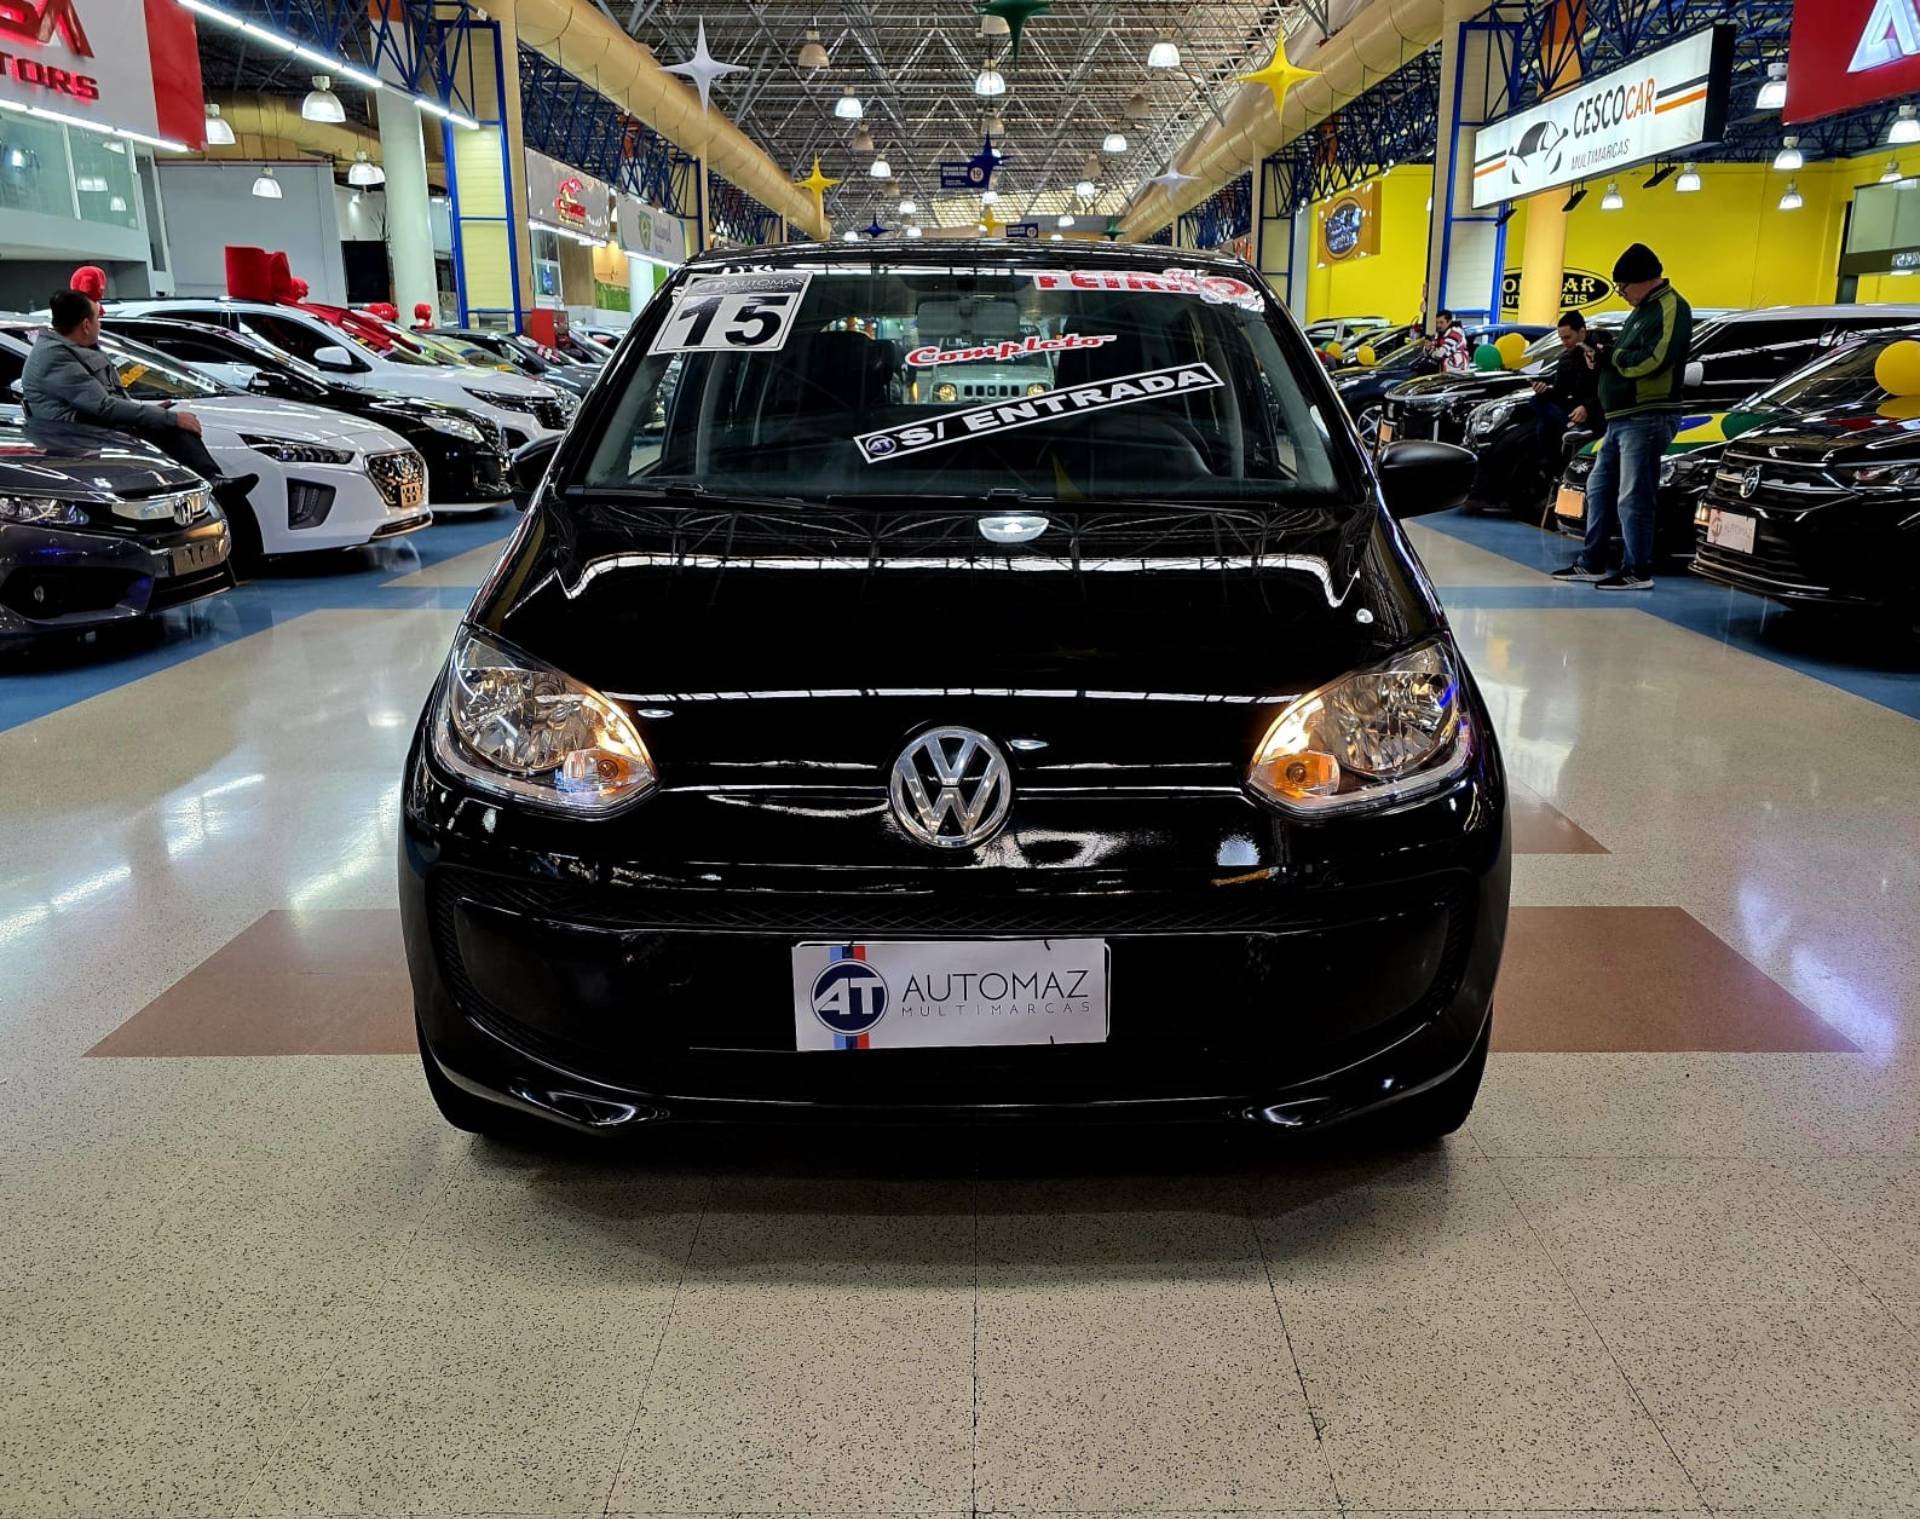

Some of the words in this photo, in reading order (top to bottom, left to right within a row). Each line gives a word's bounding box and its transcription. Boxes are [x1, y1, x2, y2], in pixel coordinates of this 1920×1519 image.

[1573, 78, 1655, 139] CESCOCAR
[1571, 138, 1630, 170] MULTIMARCAS
[679, 296, 789, 346] 15
[963, 370, 1212, 432] ENTRADA
[901, 969, 1089, 1003] AUTOMAZ
[901, 1001, 1091, 1017] MULTIMARCAS
